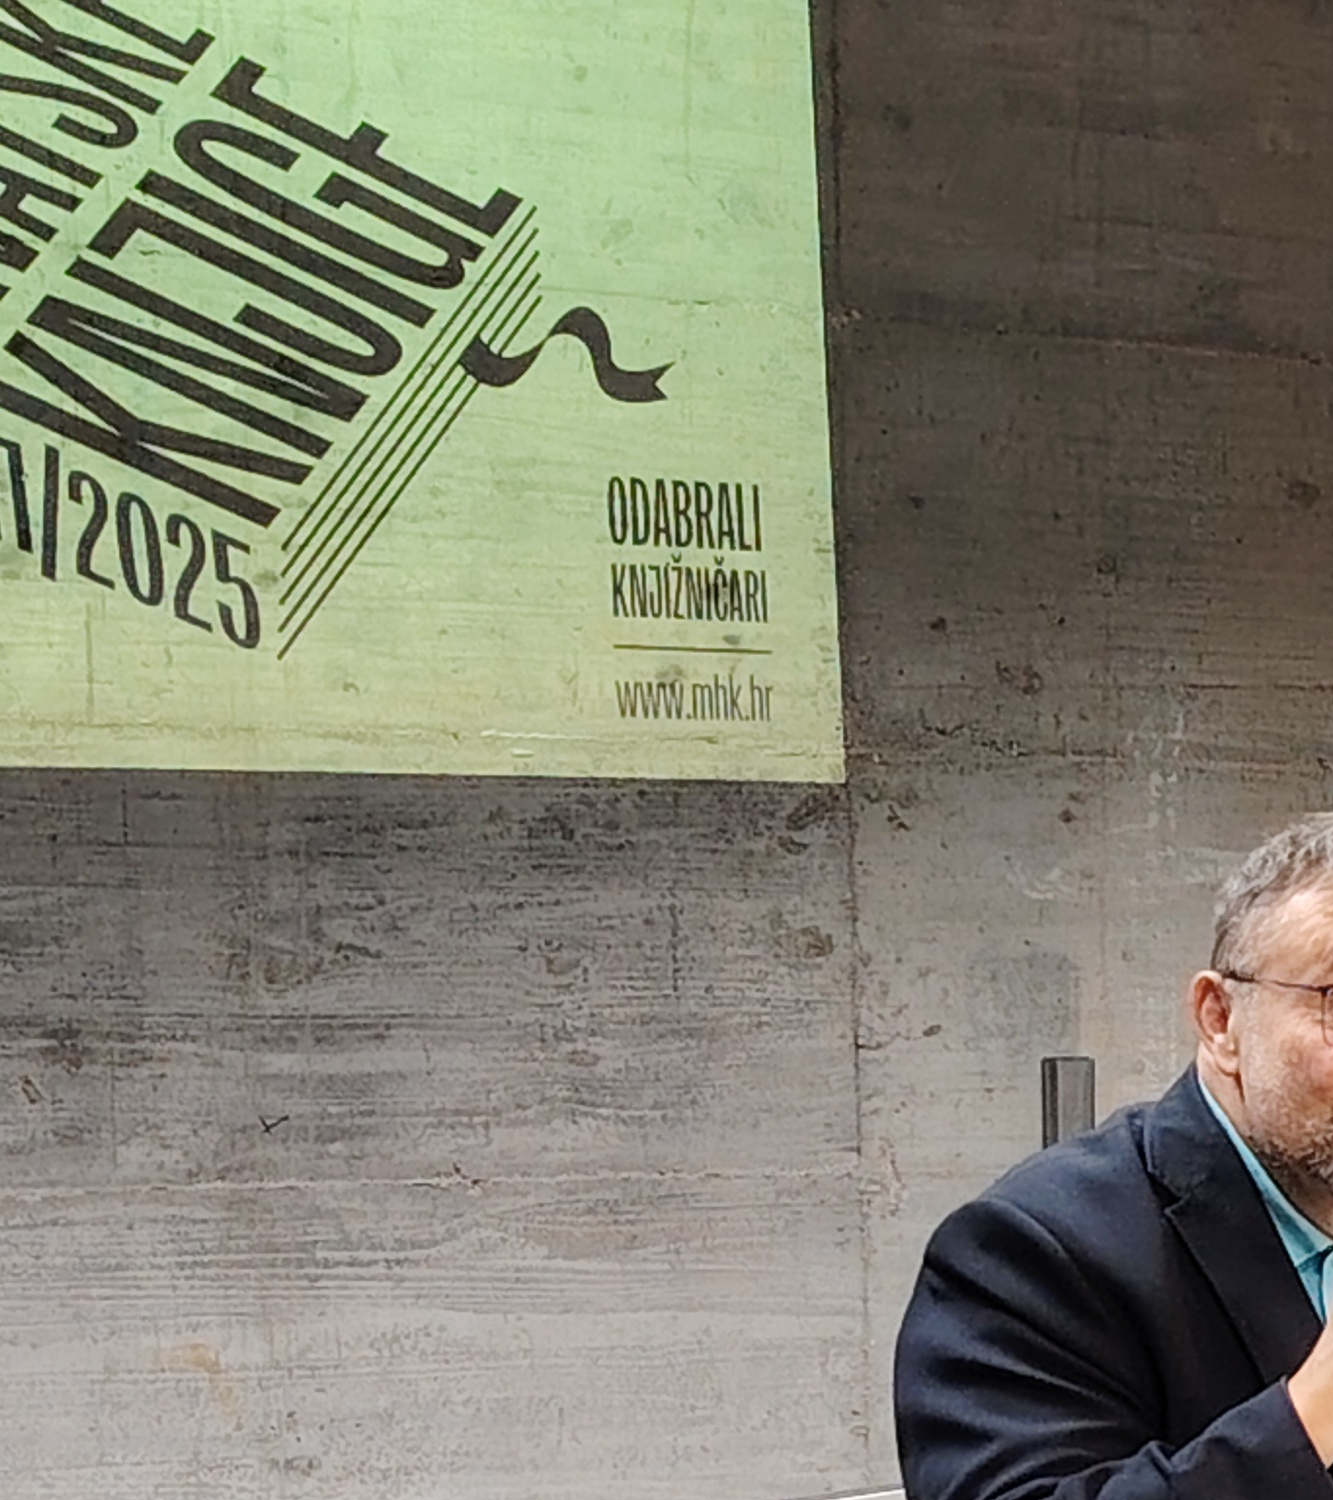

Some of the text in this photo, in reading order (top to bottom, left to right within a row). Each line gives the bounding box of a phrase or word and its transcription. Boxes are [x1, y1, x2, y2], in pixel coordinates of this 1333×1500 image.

[0, 56, 523, 528] KNJIGE
[0, 437, 261, 649] 1/2025
[607, 476, 763, 552] ODABRALI
[615, 673, 775, 722] www.mhk.hr
